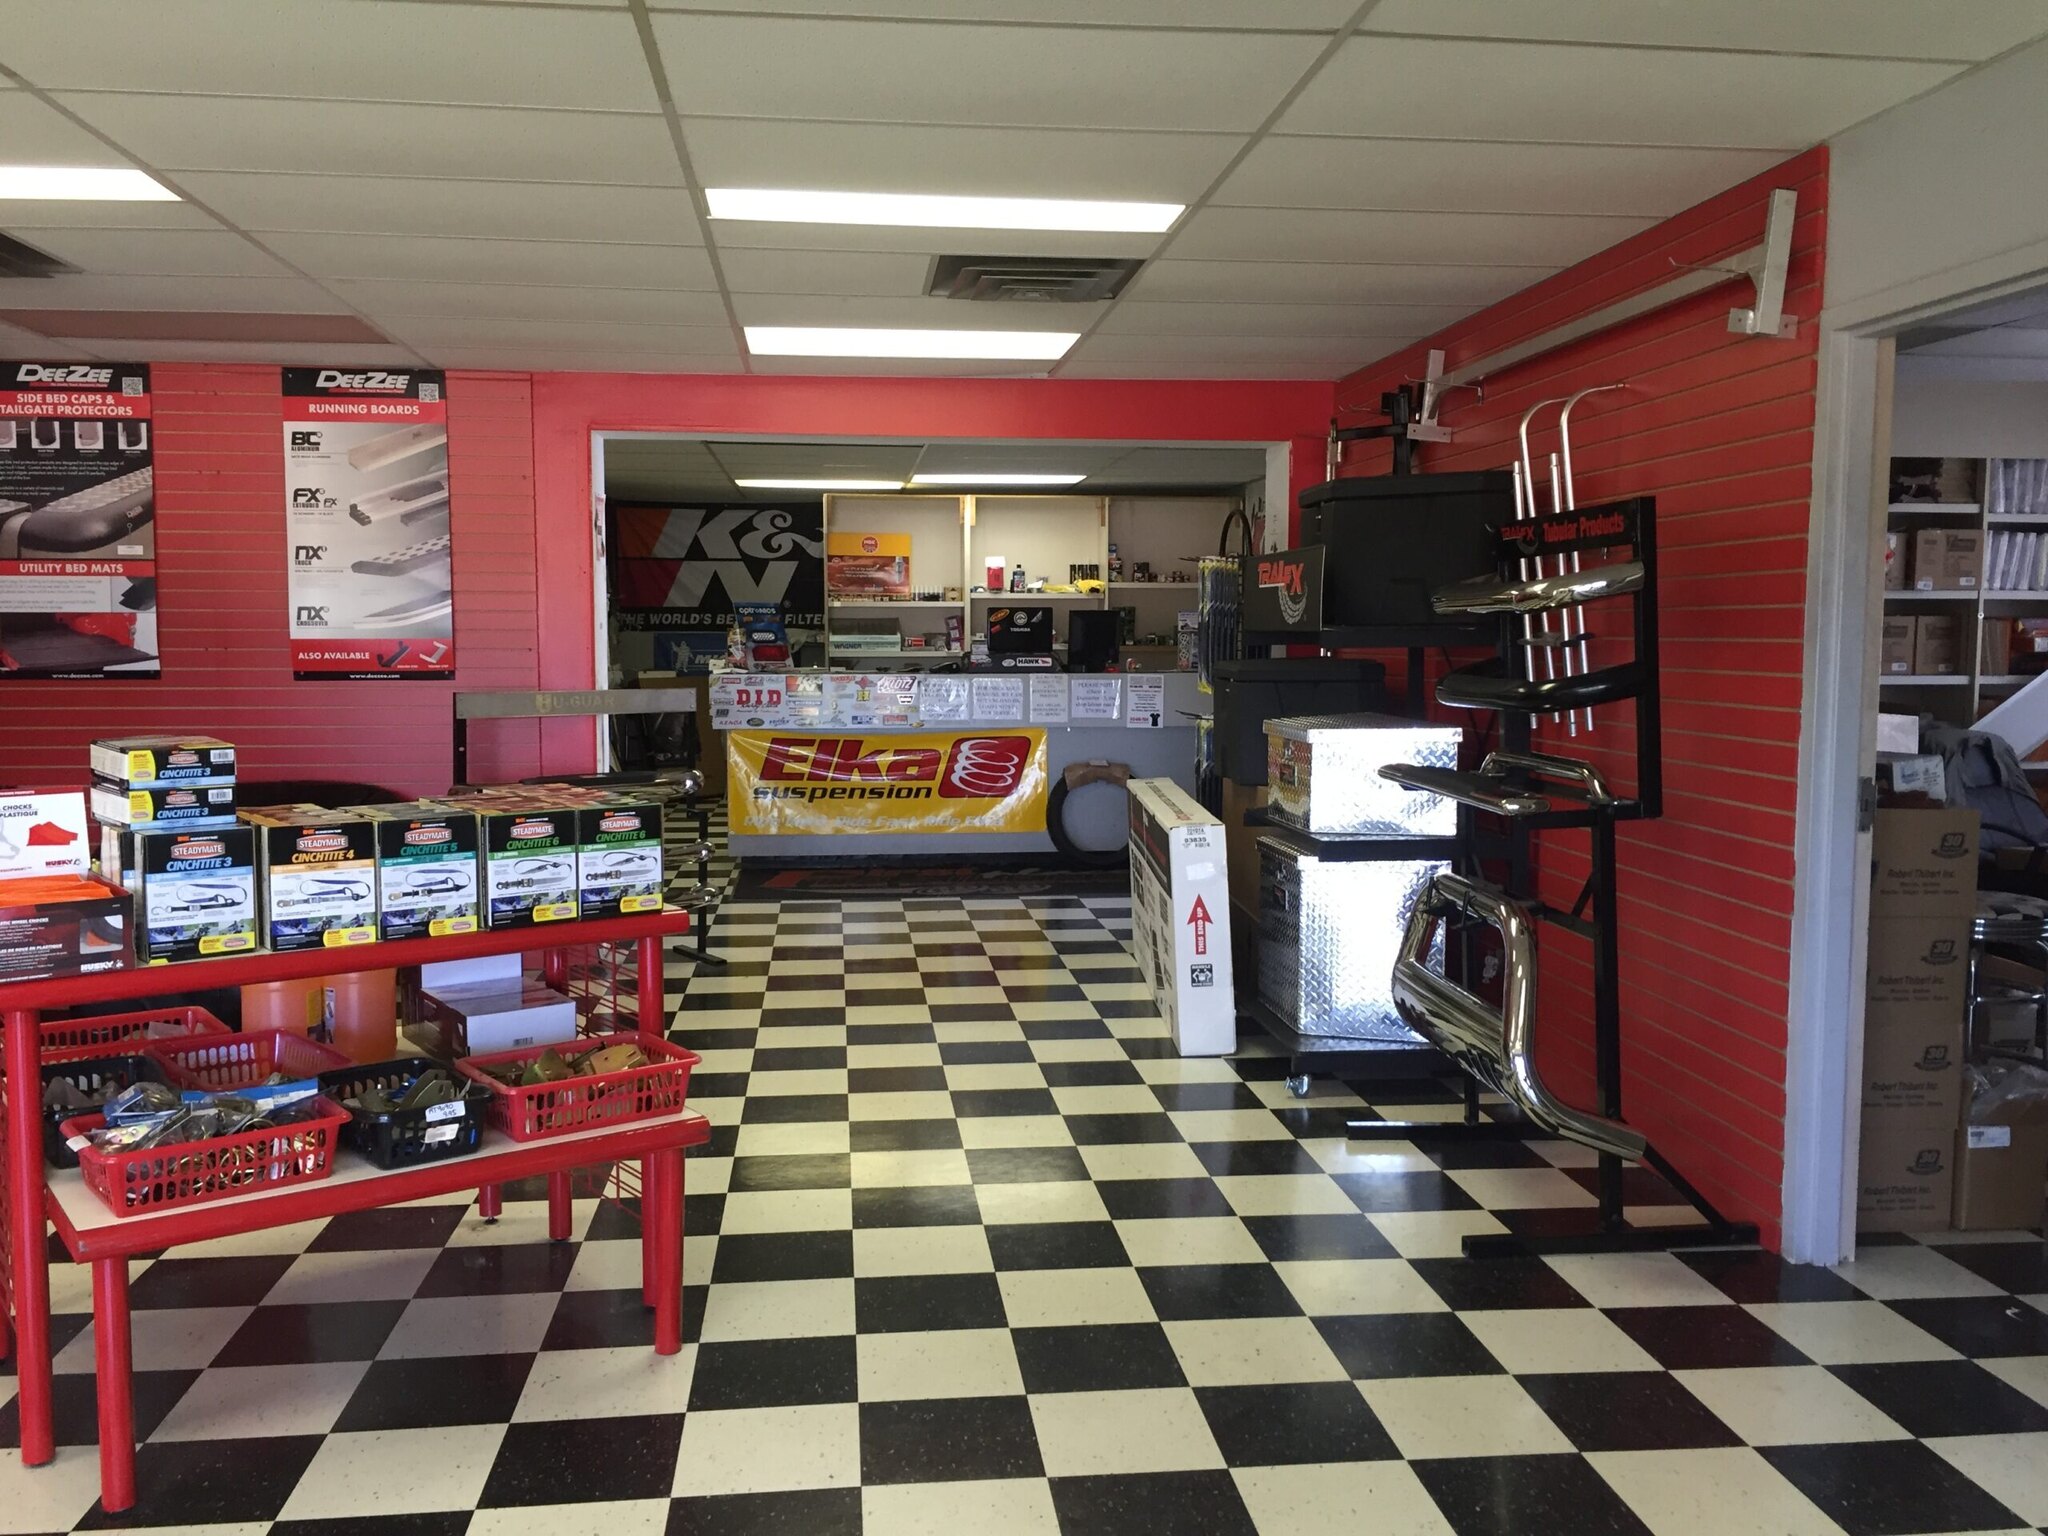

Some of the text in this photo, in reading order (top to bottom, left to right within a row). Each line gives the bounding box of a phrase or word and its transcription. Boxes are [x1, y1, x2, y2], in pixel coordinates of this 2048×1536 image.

[17, 394, 115, 404] SIDE BED CAPS &
[0, 405, 133, 416] TAILGATE PROTECTORS
[309, 404, 420, 415] RUNNING BOARDS
[291, 431, 321, 446] BC
[293, 488, 321, 502] FX
[1543, 519, 1577, 542] Tubular
[1579, 512, 1625, 538] Products
[19, 563, 124, 573] UTILITY BED MATS
[616, 613, 646, 625] THE
[649, 613, 712, 625] WORLD'S
[785, 614, 824, 625] FILTE
[324, 652, 370, 660] AVAILABLE
[882, 680, 913, 690] KLOTZ
[758, 738, 942, 781] Elka
[159, 767, 211, 778] CINCHTITE 3
[753, 785, 932, 803] suspension
[2, 803, 33, 811] CHOCKS
[157, 807, 209, 818] CINCHTITE 3
[0, 810, 38, 818] PLASTIQUE
[601, 819, 640, 829] STEADYMATE
[407, 831, 450, 841] STEADYMATE
[512, 825, 553, 836] STEADYMATE
[595, 830, 646, 843] CINCHTITE 6
[299, 837, 346, 848] STEADYMATE
[506, 836, 560, 849] CINCHTITE 6
[174, 844, 223, 856] STEADYMATE
[400, 842, 458, 856] CINCHTITE 5
[291, 849, 355, 863] CINCHTITE 4
[166, 856, 232, 872] CINCHTITE 3
[1196, 907, 1203, 918] UP
[80, 960, 114, 972] HUSKY
